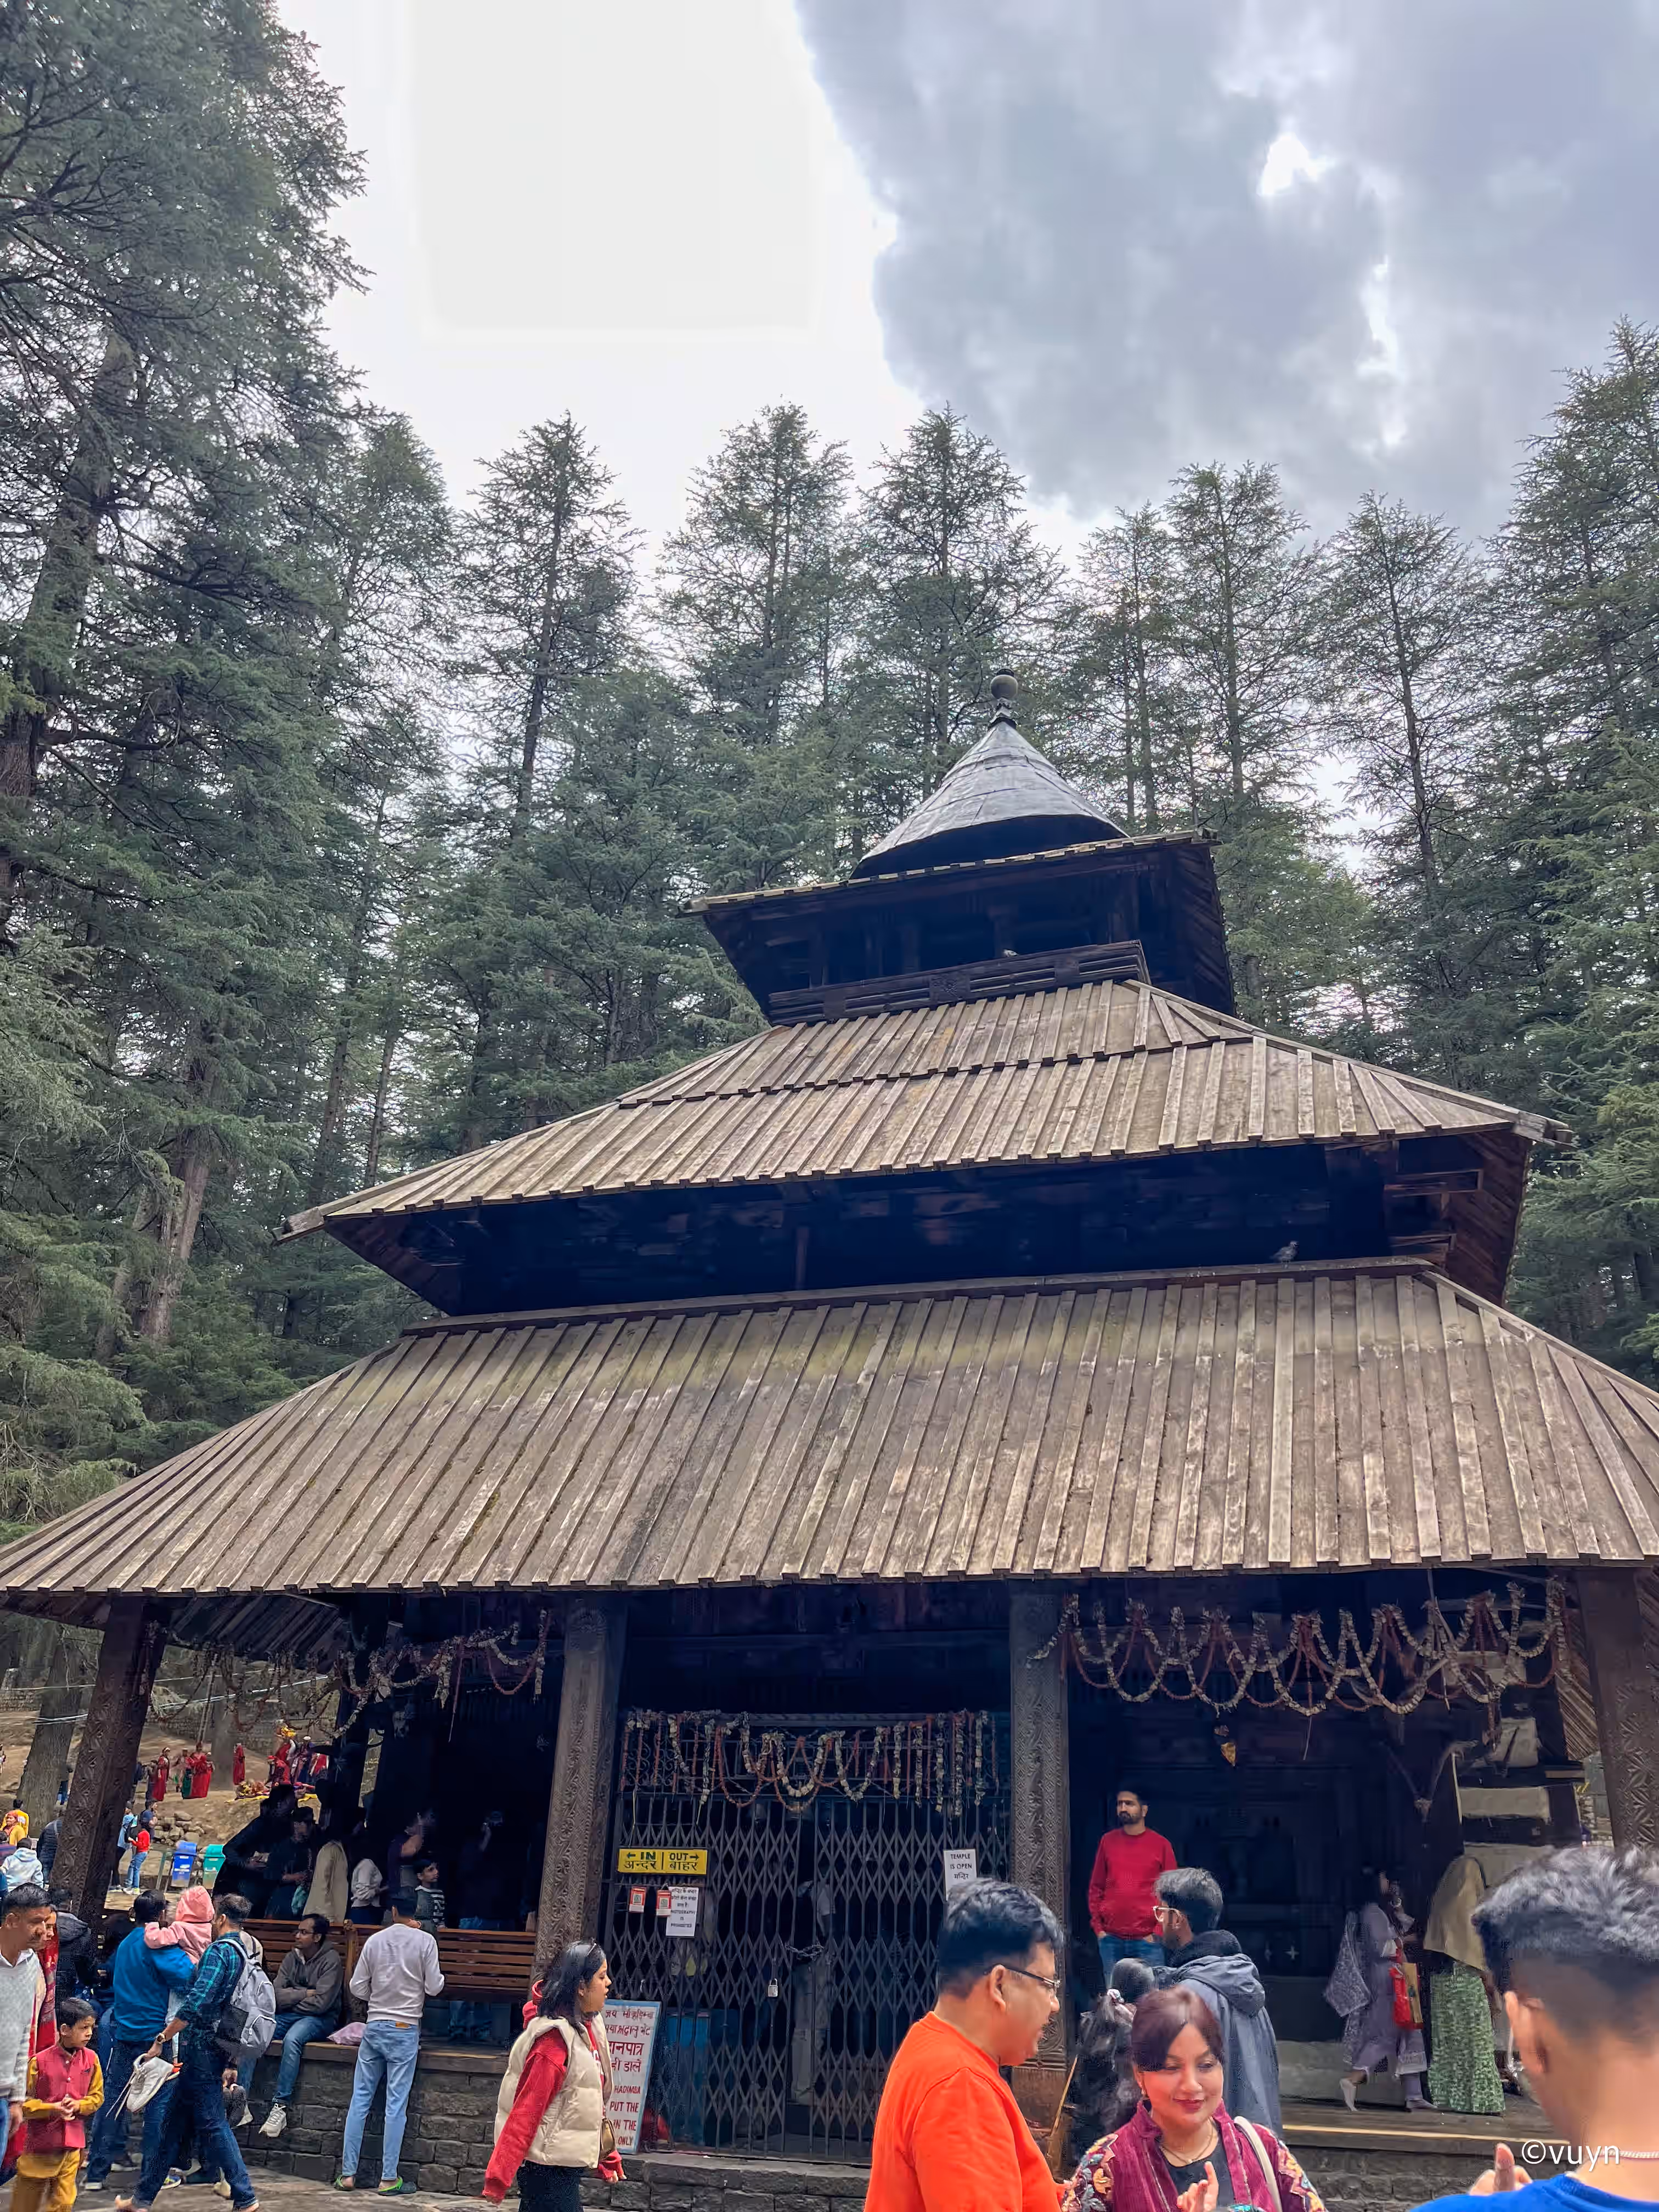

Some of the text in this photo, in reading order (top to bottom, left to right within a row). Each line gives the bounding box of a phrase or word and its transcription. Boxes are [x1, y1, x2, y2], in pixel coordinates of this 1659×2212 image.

[641, 1852, 656, 1860] IN
[669, 1853, 689, 1861] OUT
[624, 1860, 657, 1870] अन्दर
[669, 1861, 698, 1871] बाहर
[606, 2010, 617, 2018] जय
[614, 2085, 640, 2094] HADIMBA
[610, 2101, 639, 2113] PUT THE
[623, 2119, 637, 2131] THE
[618, 2136, 633, 2146] ONLY
